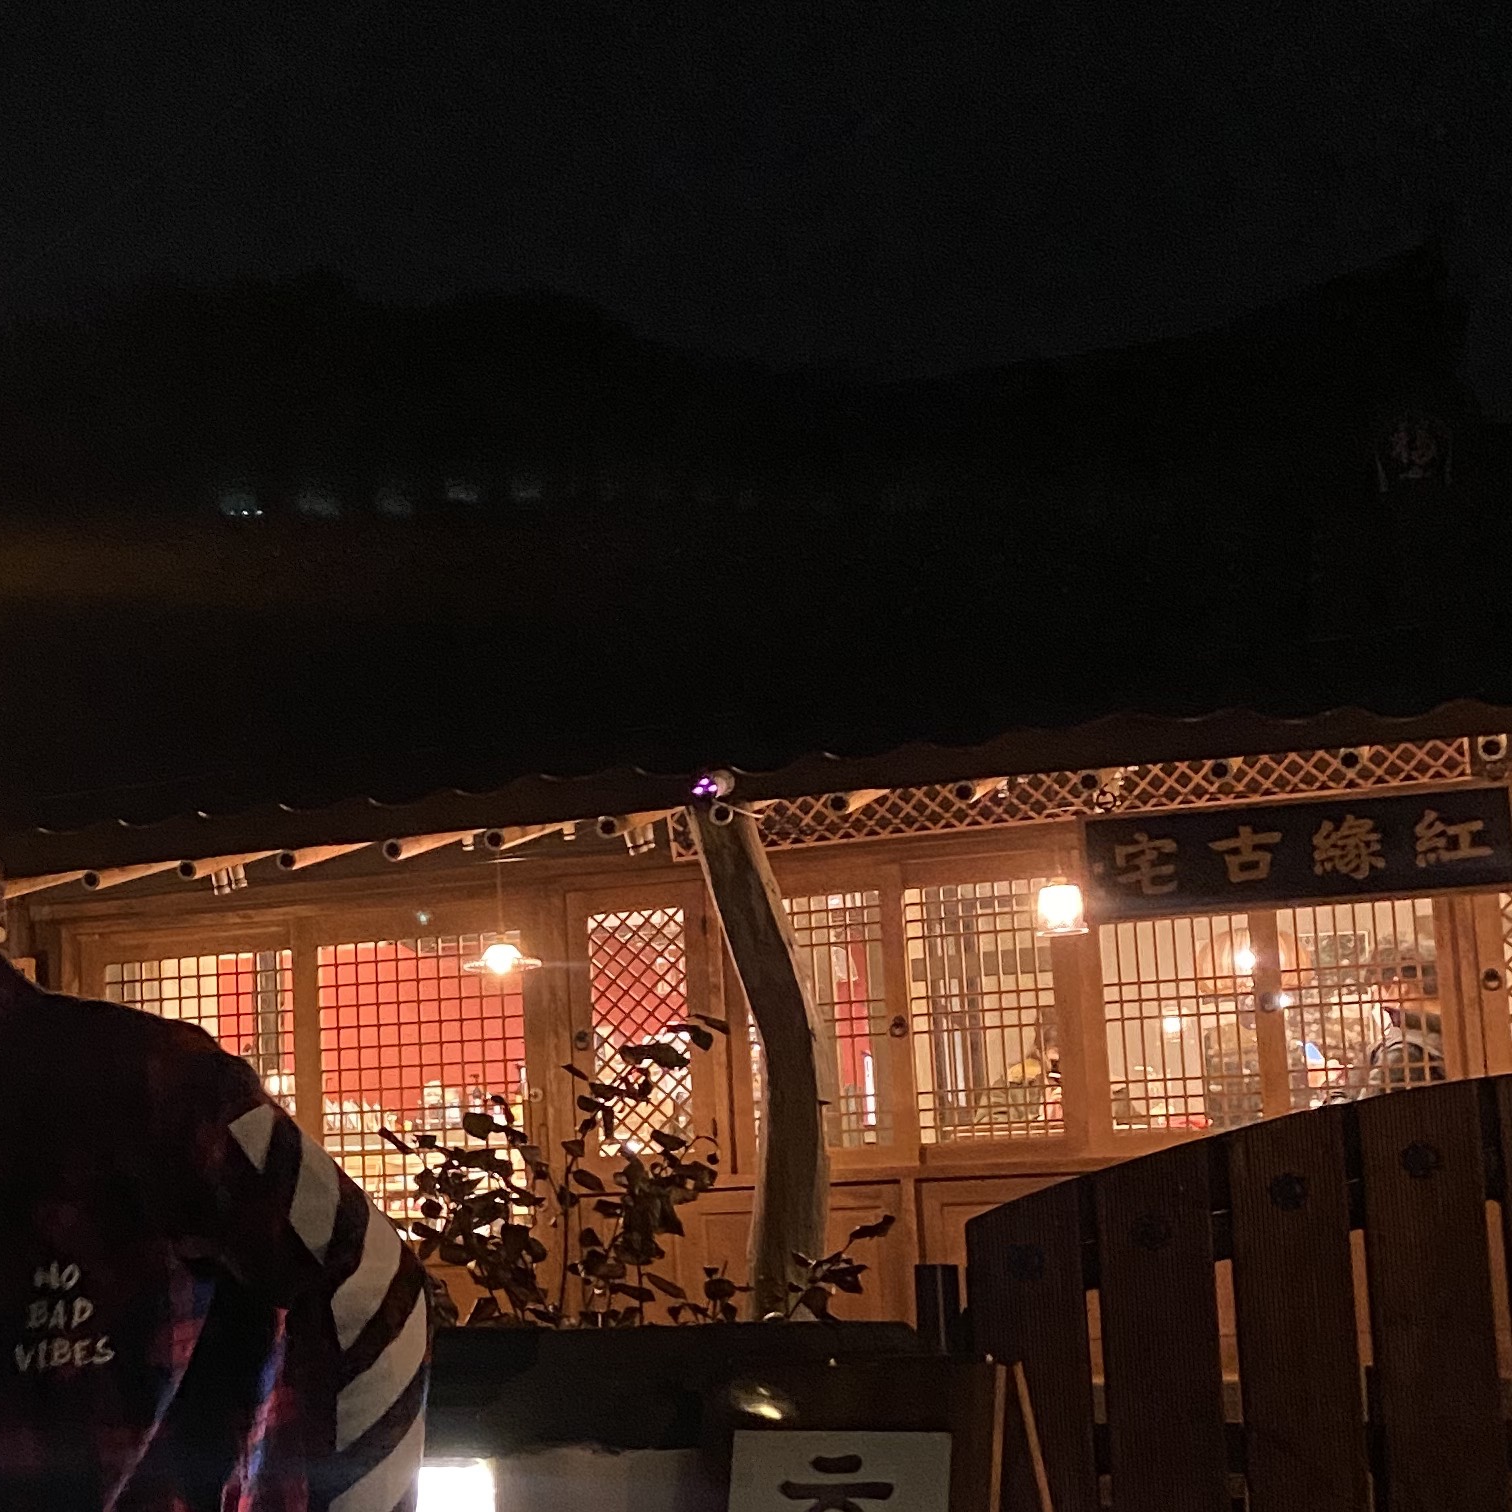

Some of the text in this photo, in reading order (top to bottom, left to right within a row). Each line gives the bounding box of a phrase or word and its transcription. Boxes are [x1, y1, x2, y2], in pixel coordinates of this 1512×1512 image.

[33, 1259, 82, 1291] NO
[26, 1297, 94, 1329] BAD
[14, 1335, 116, 1373] VIBES
